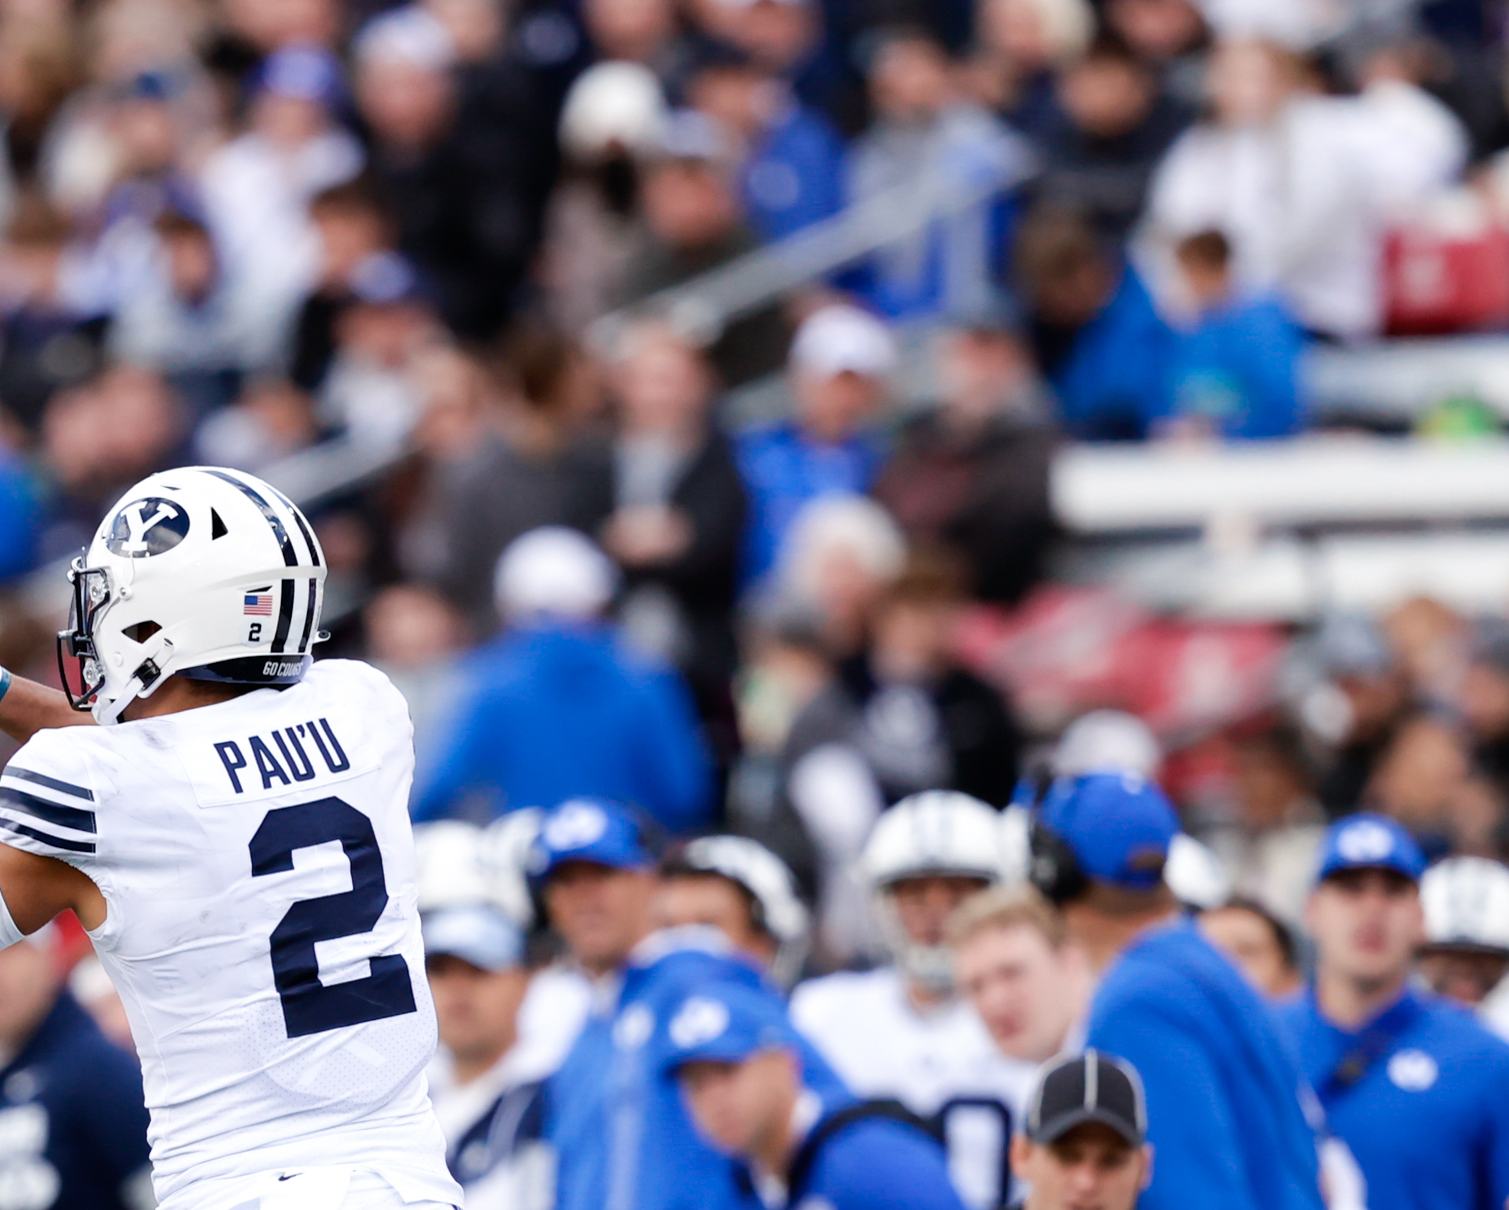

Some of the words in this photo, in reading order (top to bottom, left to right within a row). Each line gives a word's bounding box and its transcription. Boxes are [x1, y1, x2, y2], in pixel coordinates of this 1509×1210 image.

[120, 501, 179, 551] Y
[248, 622, 262, 642] 2
[262, 661, 278, 677] GO
[213, 717, 351, 794] PAU'U
[248, 795, 418, 1039] 2
